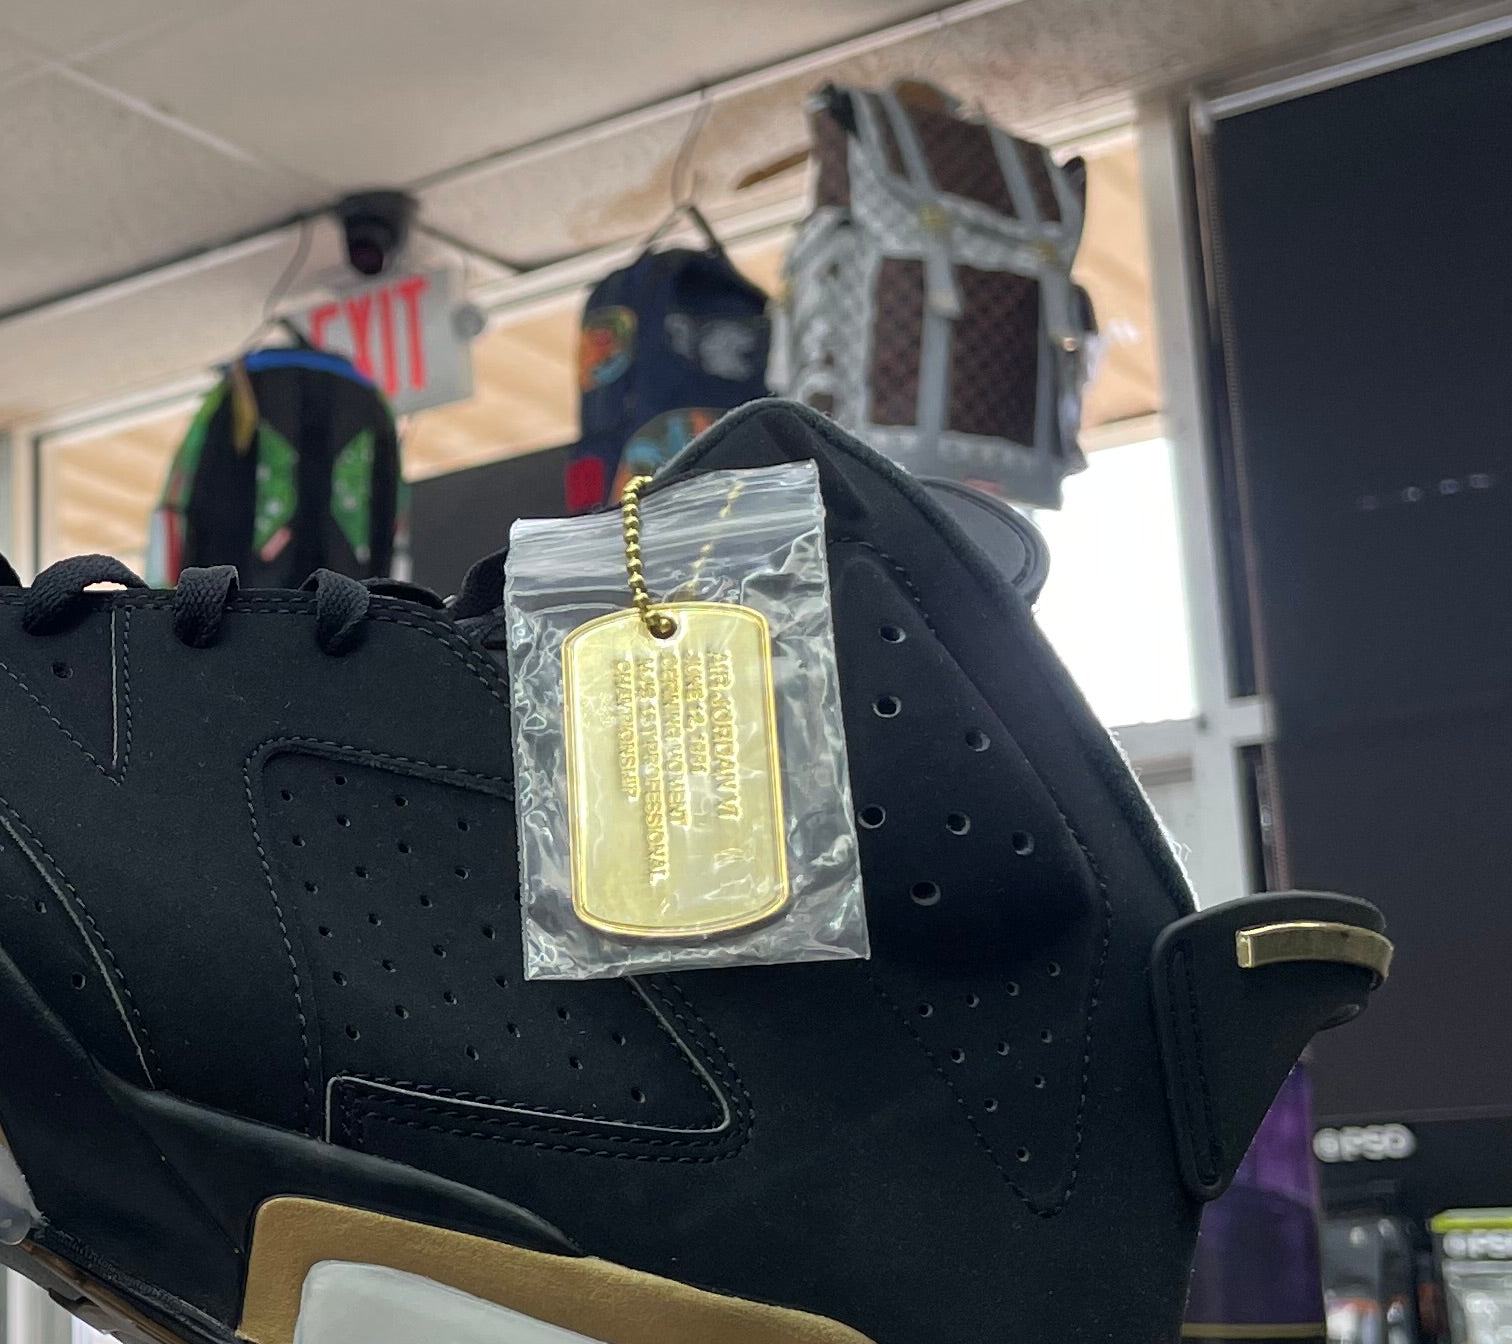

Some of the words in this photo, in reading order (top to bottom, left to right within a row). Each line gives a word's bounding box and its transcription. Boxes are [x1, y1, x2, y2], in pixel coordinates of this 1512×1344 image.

[660, 653, 681, 738] DEFINING
[685, 651, 704, 700] JUNE
[707, 652, 732, 689] AIR
[617, 660, 637, 799] CHAMPIONSHIP
[712, 693, 737, 791] JORDAN
[642, 741, 665, 883] PROFESSIONAL
[666, 744, 687, 826] MOMENT
[717, 796, 740, 820] VI
